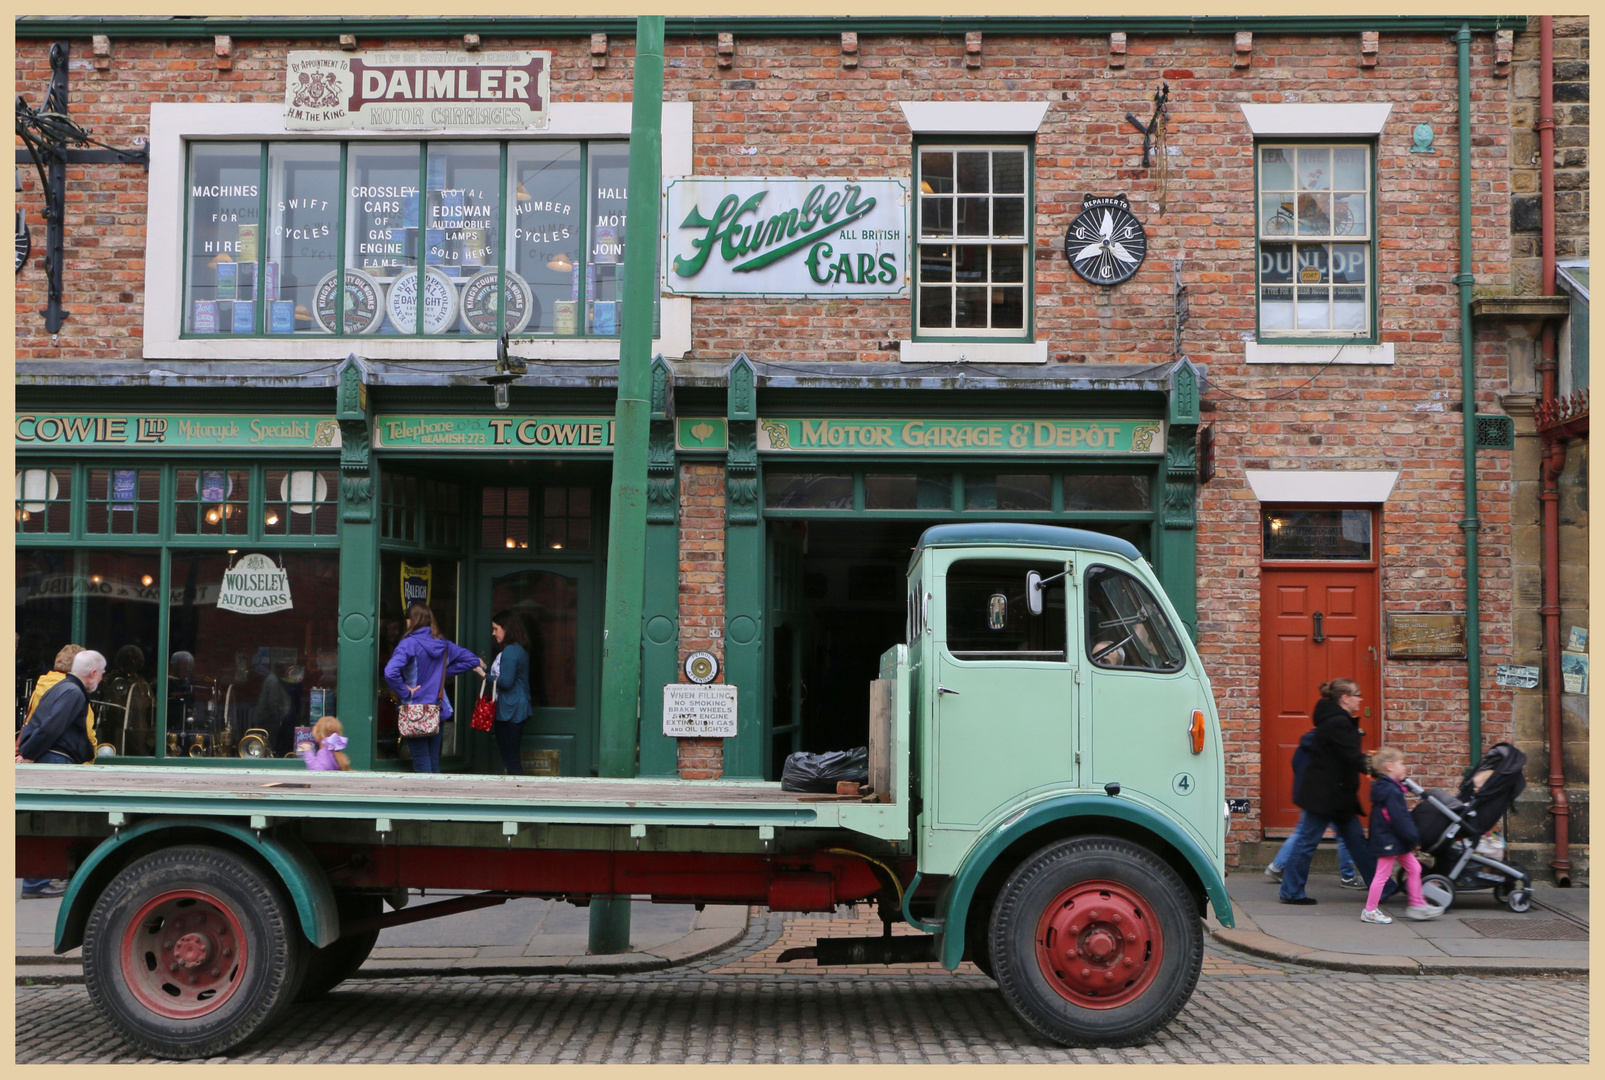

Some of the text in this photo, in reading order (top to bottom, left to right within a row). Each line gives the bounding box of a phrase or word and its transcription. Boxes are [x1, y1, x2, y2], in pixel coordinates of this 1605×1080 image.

[291, 60, 348, 73] BY APPOINTMENT TO
[362, 70, 530, 100] DAIMLER
[306, 111, 320, 122] THE
[370, 107, 424, 125] MOTOR
[192, 186, 258, 198] MACHINES
[351, 186, 416, 198] CROSSLEY
[440, 188, 484, 200] ROYAL
[278, 198, 328, 212] SWIFT
[364, 202, 400, 213] CARS
[514, 202, 571, 216] HUMBER
[1083, 198, 1128, 209] REPAIRER TO
[212, 214, 238, 222] FOR
[432, 206, 491, 217] EDISWAN
[374, 218, 389, 226] OF
[432, 220, 490, 229] AUTOMOBILE
[274, 225, 329, 240] CYCLES
[369, 230, 392, 240] GAS
[446, 232, 478, 240] LAMPS
[514, 228, 570, 243] CYCLES
[673, 184, 877, 278] Humber
[840, 230, 900, 240] ALL BRITISH
[204, 241, 242, 252] HIRE
[360, 244, 402, 254] ENGINE
[430, 246, 493, 260] SOLD HERE
[592, 244, 626, 255] JOIN
[363, 258, 398, 267] FAME
[804, 241, 898, 284] CARS
[1261, 251, 1364, 274] DUNLOP
[404, 282, 437, 296] ROAL
[466, 287, 478, 309] KINGS
[476, 276, 498, 288] COUNT
[476, 285, 491, 301] WHITE
[394, 294, 406, 322] EXTRA
[430, 278, 448, 323] PETROLEUM
[401, 296, 442, 306] DAYGHT
[14, 416, 128, 443] COWIE
[178, 419, 240, 442] Motorcycle
[250, 418, 311, 443] Specialist
[385, 420, 454, 441] Telephone
[488, 419, 512, 444] T.
[516, 419, 602, 446] COWIE
[800, 420, 1121, 449] MOTOR GARAGE & DEPÔT
[226, 574, 286, 592] WOLSELEY
[404, 582, 427, 600] RALEIGH
[221, 593, 288, 608] AUTOCARS
[692, 651, 712, 660] PETROL
[688, 670, 716, 683] ATTENDANT
[1178, 776, 1190, 790] 4
